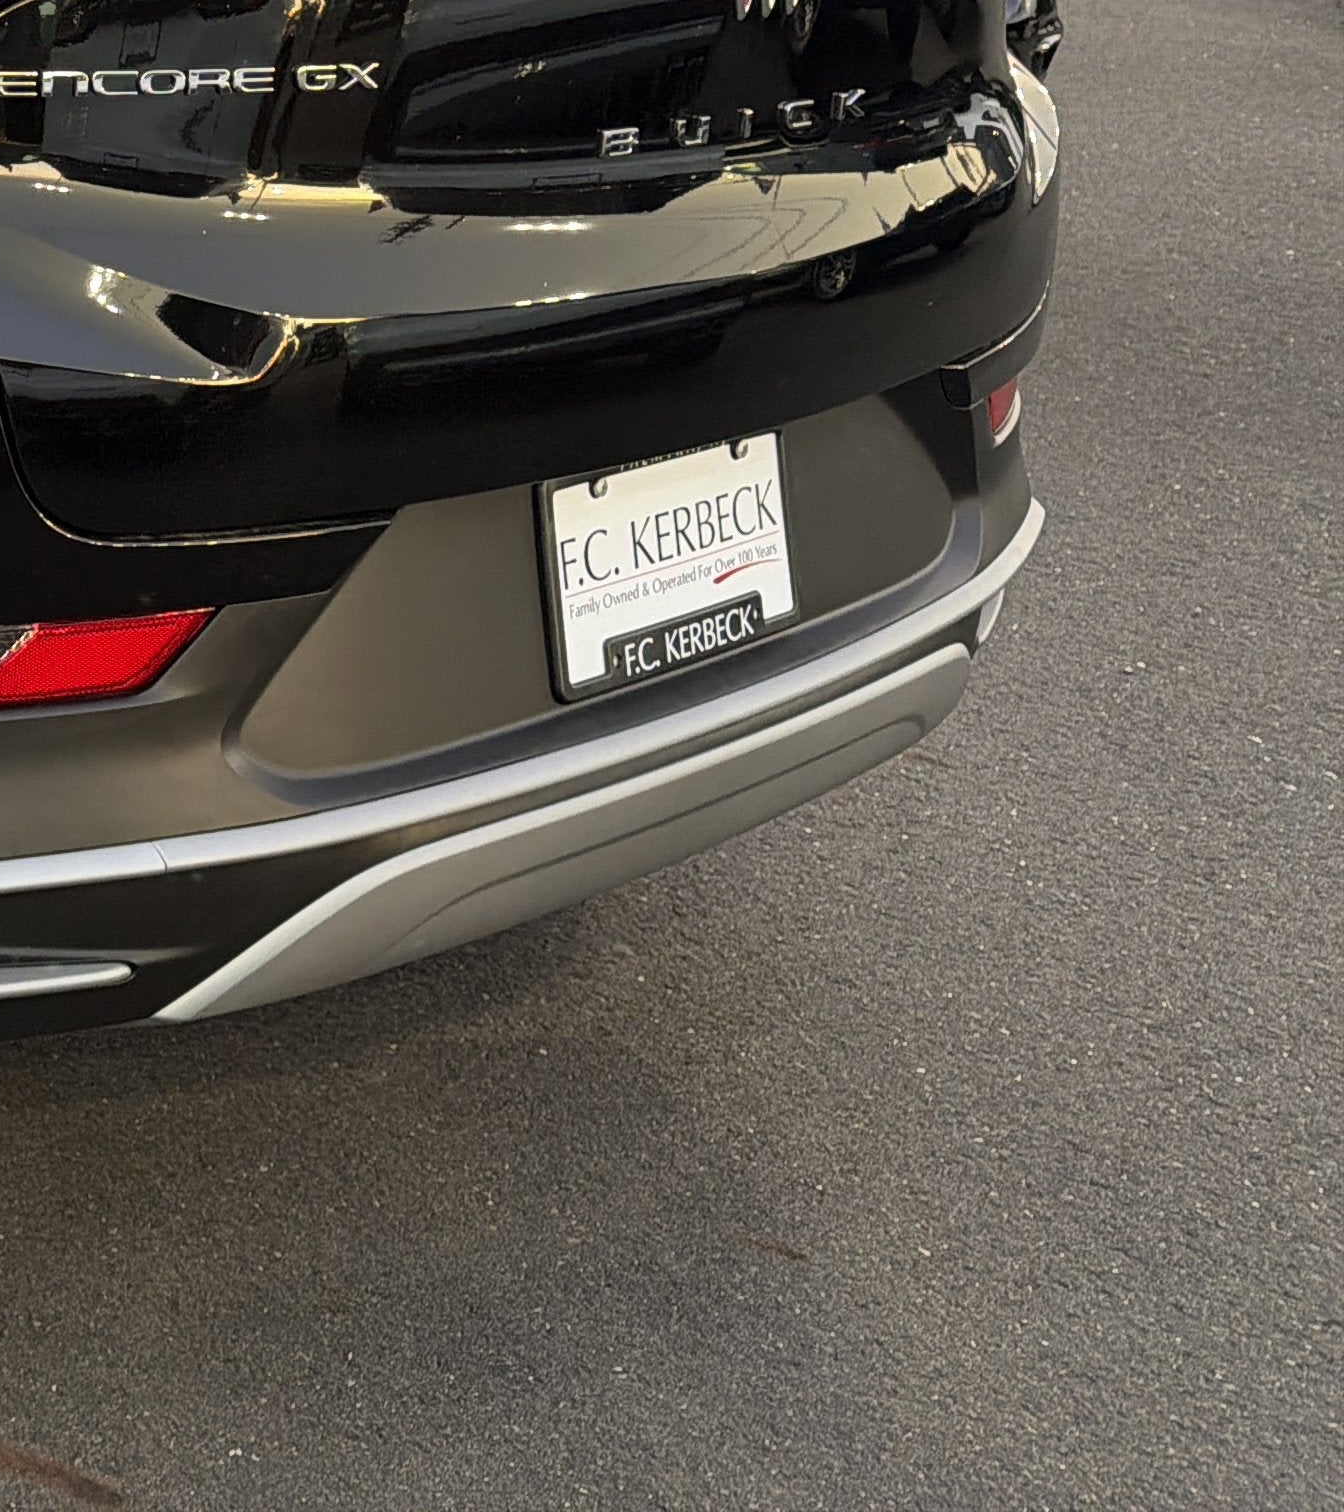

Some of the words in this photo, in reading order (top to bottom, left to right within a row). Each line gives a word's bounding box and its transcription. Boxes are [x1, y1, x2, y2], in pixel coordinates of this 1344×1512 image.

[296, 62, 380, 91] GX
[597, 88, 866, 158] BUICK
[560, 529, 620, 590] F.C.
[630, 479, 778, 570] KERBECK
[568, 596, 601, 620] Family
[602, 586, 640, 609] Owned
[642, 583, 650, 596] &
[652, 567, 697, 595] Operated
[698, 563, 713, 580] For
[714, 554, 736, 574] Over
[737, 549, 754, 564] 100
[755, 543, 777, 560] Years
[624, 637, 661, 677] F.C.
[664, 603, 755, 664] KERBECK
